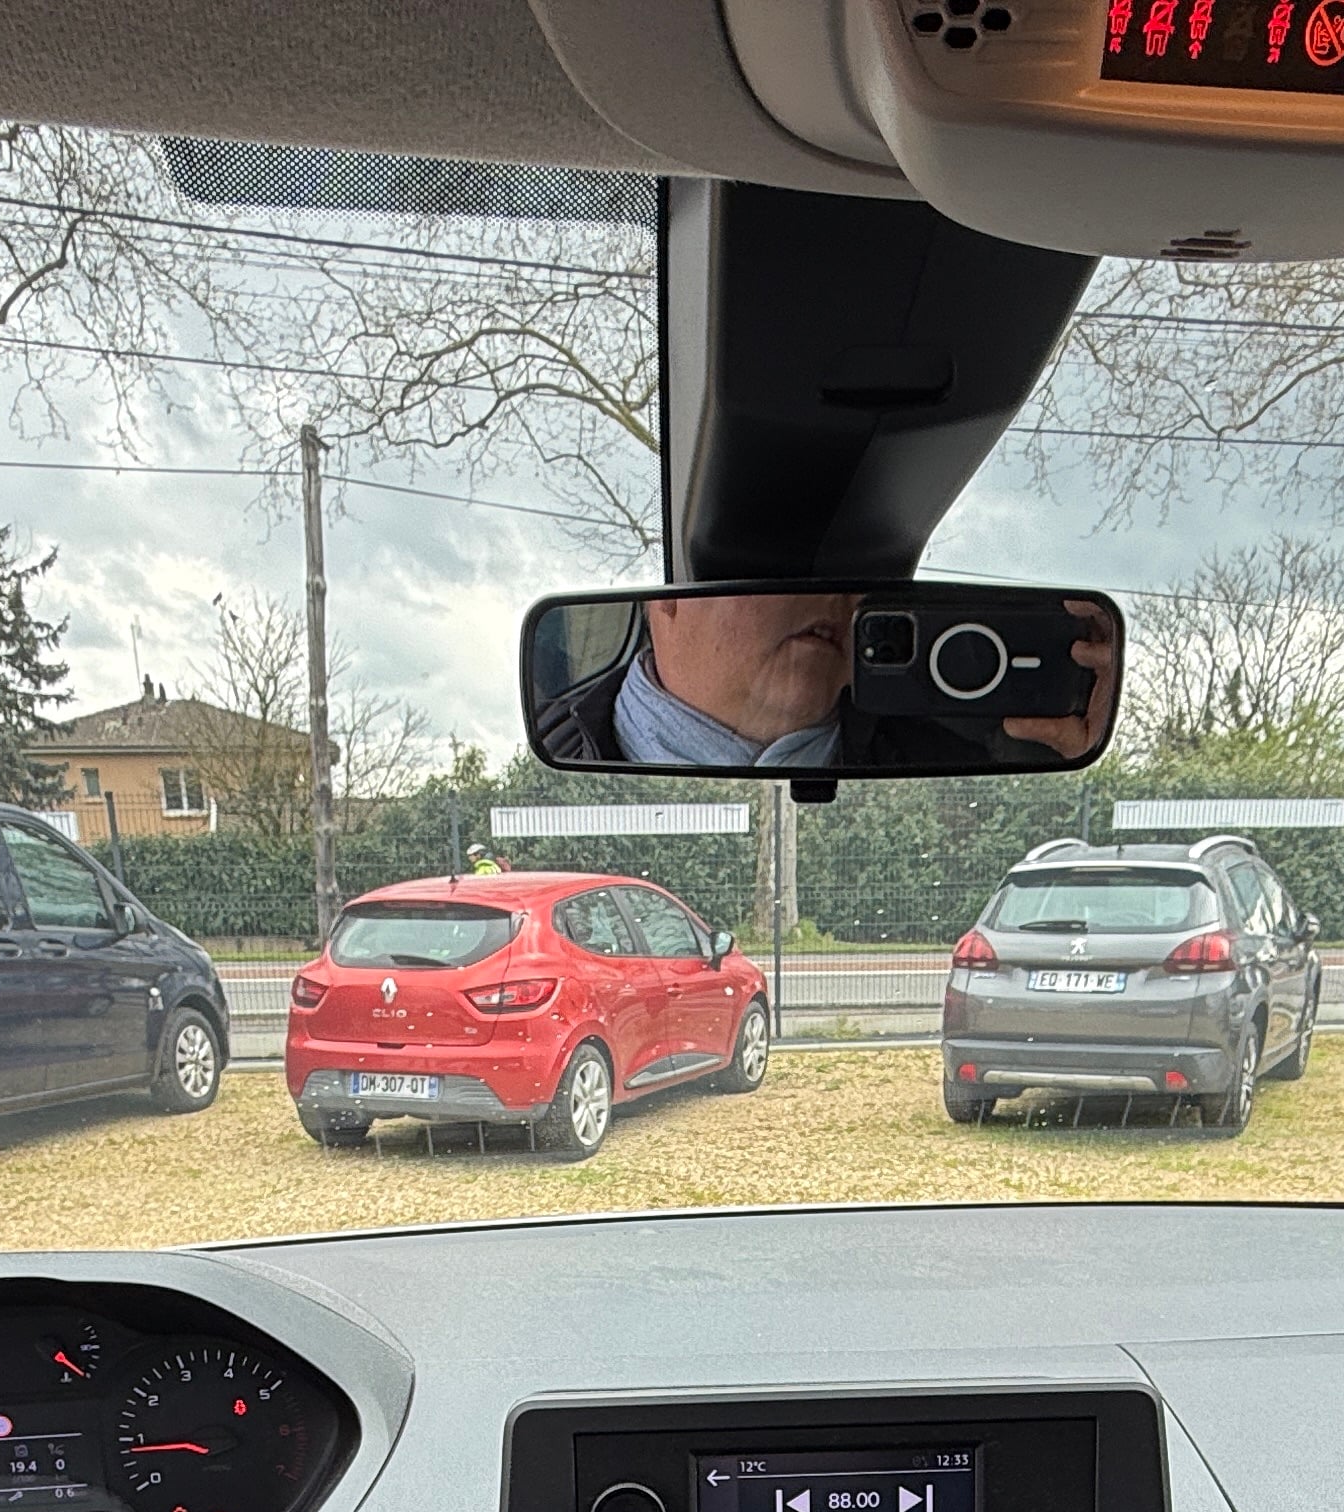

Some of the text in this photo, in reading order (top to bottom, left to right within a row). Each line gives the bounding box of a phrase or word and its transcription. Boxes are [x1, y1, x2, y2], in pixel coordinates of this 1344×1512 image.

[372, 1008, 407, 1018] CLIO
[181, 1370, 192, 1382] 3
[223, 1368, 234, 1379] 4
[259, 1389, 271, 1400] 5
[148, 1395, 159, 1407] 2
[138, 1433, 144, 1444] 1
[55, 1458, 66, 1470] 0
[936, 1454, 969, 1467] 12:33
[10, 1461, 37, 1473] 19.4
[739, 1461, 767, 1473] 12°C
[150, 1472, 161, 1483] 0
[828, 1491, 880, 1510] 88.00
